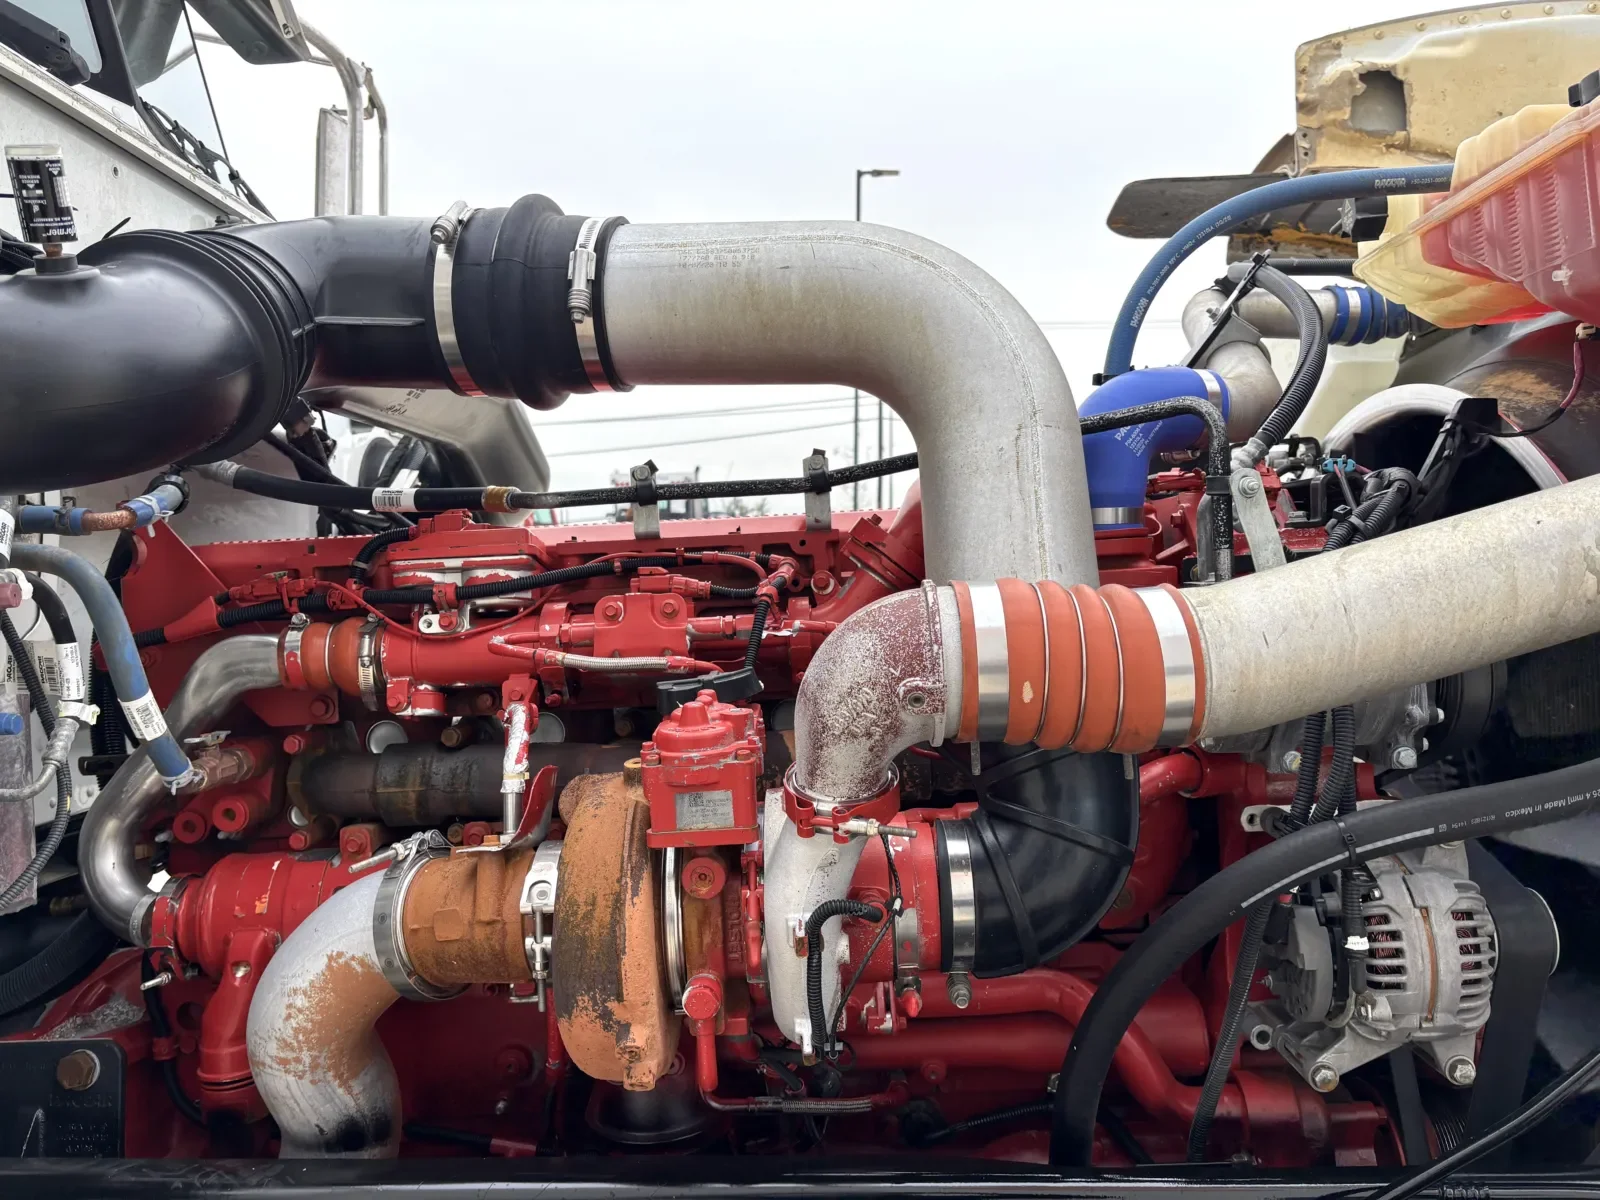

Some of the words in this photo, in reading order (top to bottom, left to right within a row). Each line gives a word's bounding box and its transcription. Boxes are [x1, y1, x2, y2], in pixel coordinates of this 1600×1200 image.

[1129, 297, 1149, 328] PACCAR
[1136, 444, 1146, 457] MADE
[1148, 420, 1163, 440] VIETNAM
[1505, 807, 1533, 818] Mexico
[1544, 799, 1566, 809] Made
[727, 893, 744, 964] HOLSET
